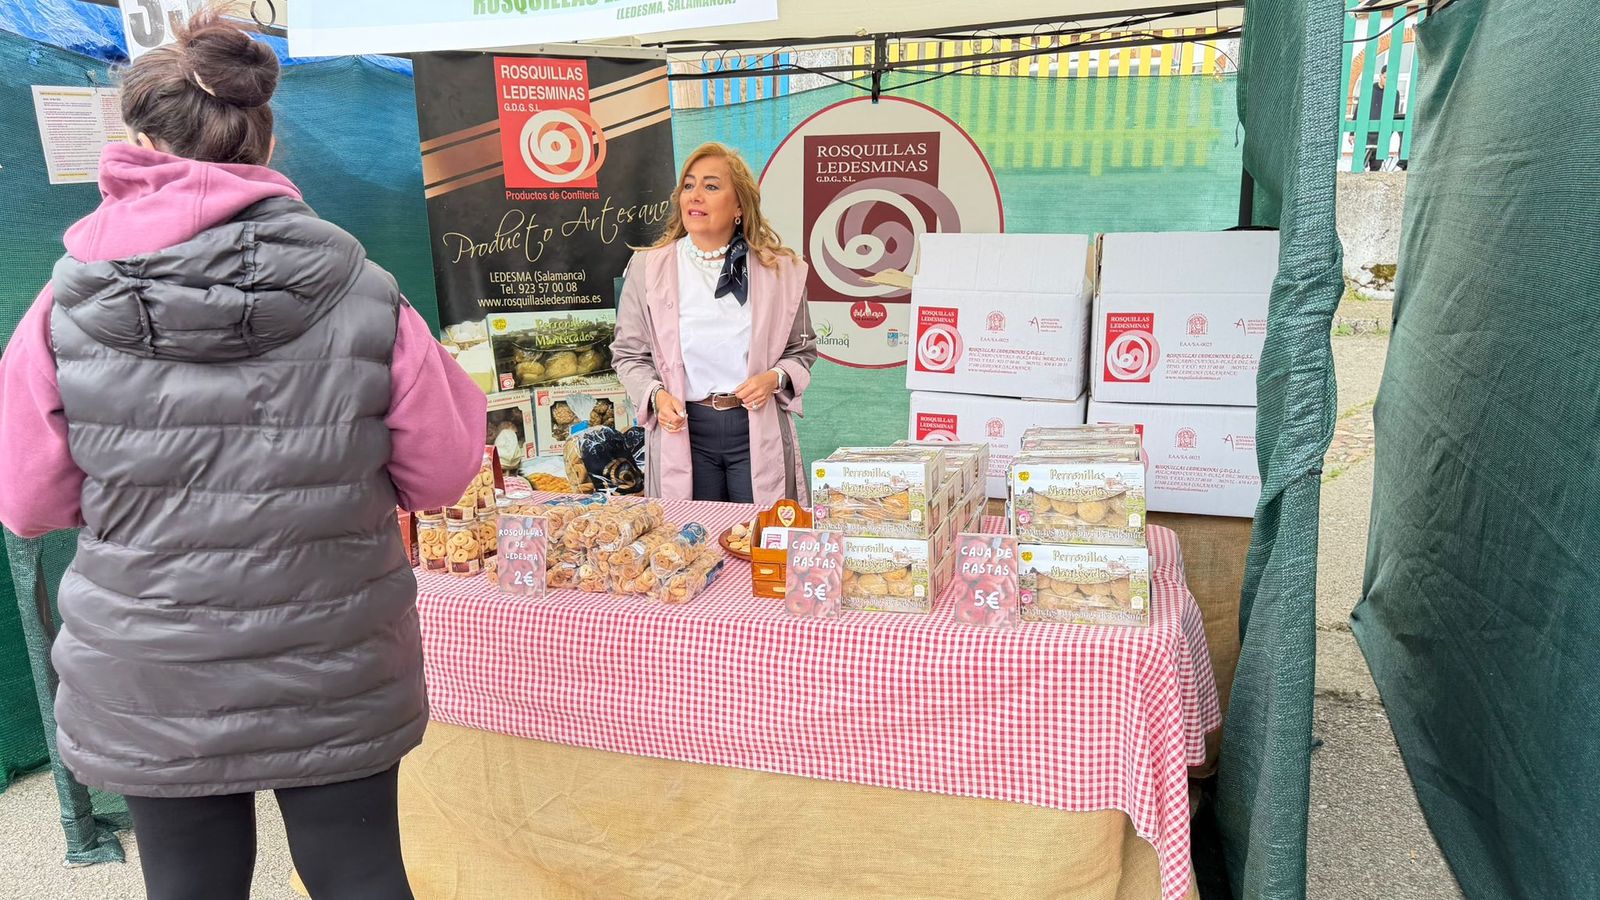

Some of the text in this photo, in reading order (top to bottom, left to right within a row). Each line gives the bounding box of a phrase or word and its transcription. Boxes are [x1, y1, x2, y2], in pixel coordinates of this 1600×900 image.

[473, 0, 597, 15] ROSQU
[668, 0, 737, 12] SALAMAN
[501, 65, 584, 80] ROSQUILLAS
[503, 85, 586, 101] LEDESMINAS
[816, 142, 928, 159] ROSQUILLAS
[816, 159, 929, 174] LEDESMINAS
[505, 190, 547, 200] Productos
[549, 190, 559, 200] de
[442, 196, 669, 264] Producto Artesano
[489, 269, 587, 283] LEDESMA (Salamanca)
[500, 282, 578, 295] Tel. 923 57 00 08
[477, 294, 602, 308] www.rosquillasledesminas.es
[816, 336, 850, 348] alamaq
[843, 466, 891, 478] Perronillas
[1049, 469, 1106, 480] Perronillas
[498, 528, 544, 537] ROSQUILLAS
[792, 540, 840, 552] CAJA DE
[846, 541, 894, 553] Perronillas
[961, 545, 1013, 558] CAJA DE
[505, 552, 538, 560] LEDESMA
[793, 555, 836, 569] PASTAS
[1052, 549, 1109, 562] Perronillas
[962, 562, 1009, 576] PASTAS
[514, 570, 534, 587] 2€
[803, 581, 827, 601] 5€
[974, 589, 1000, 610] 5€
